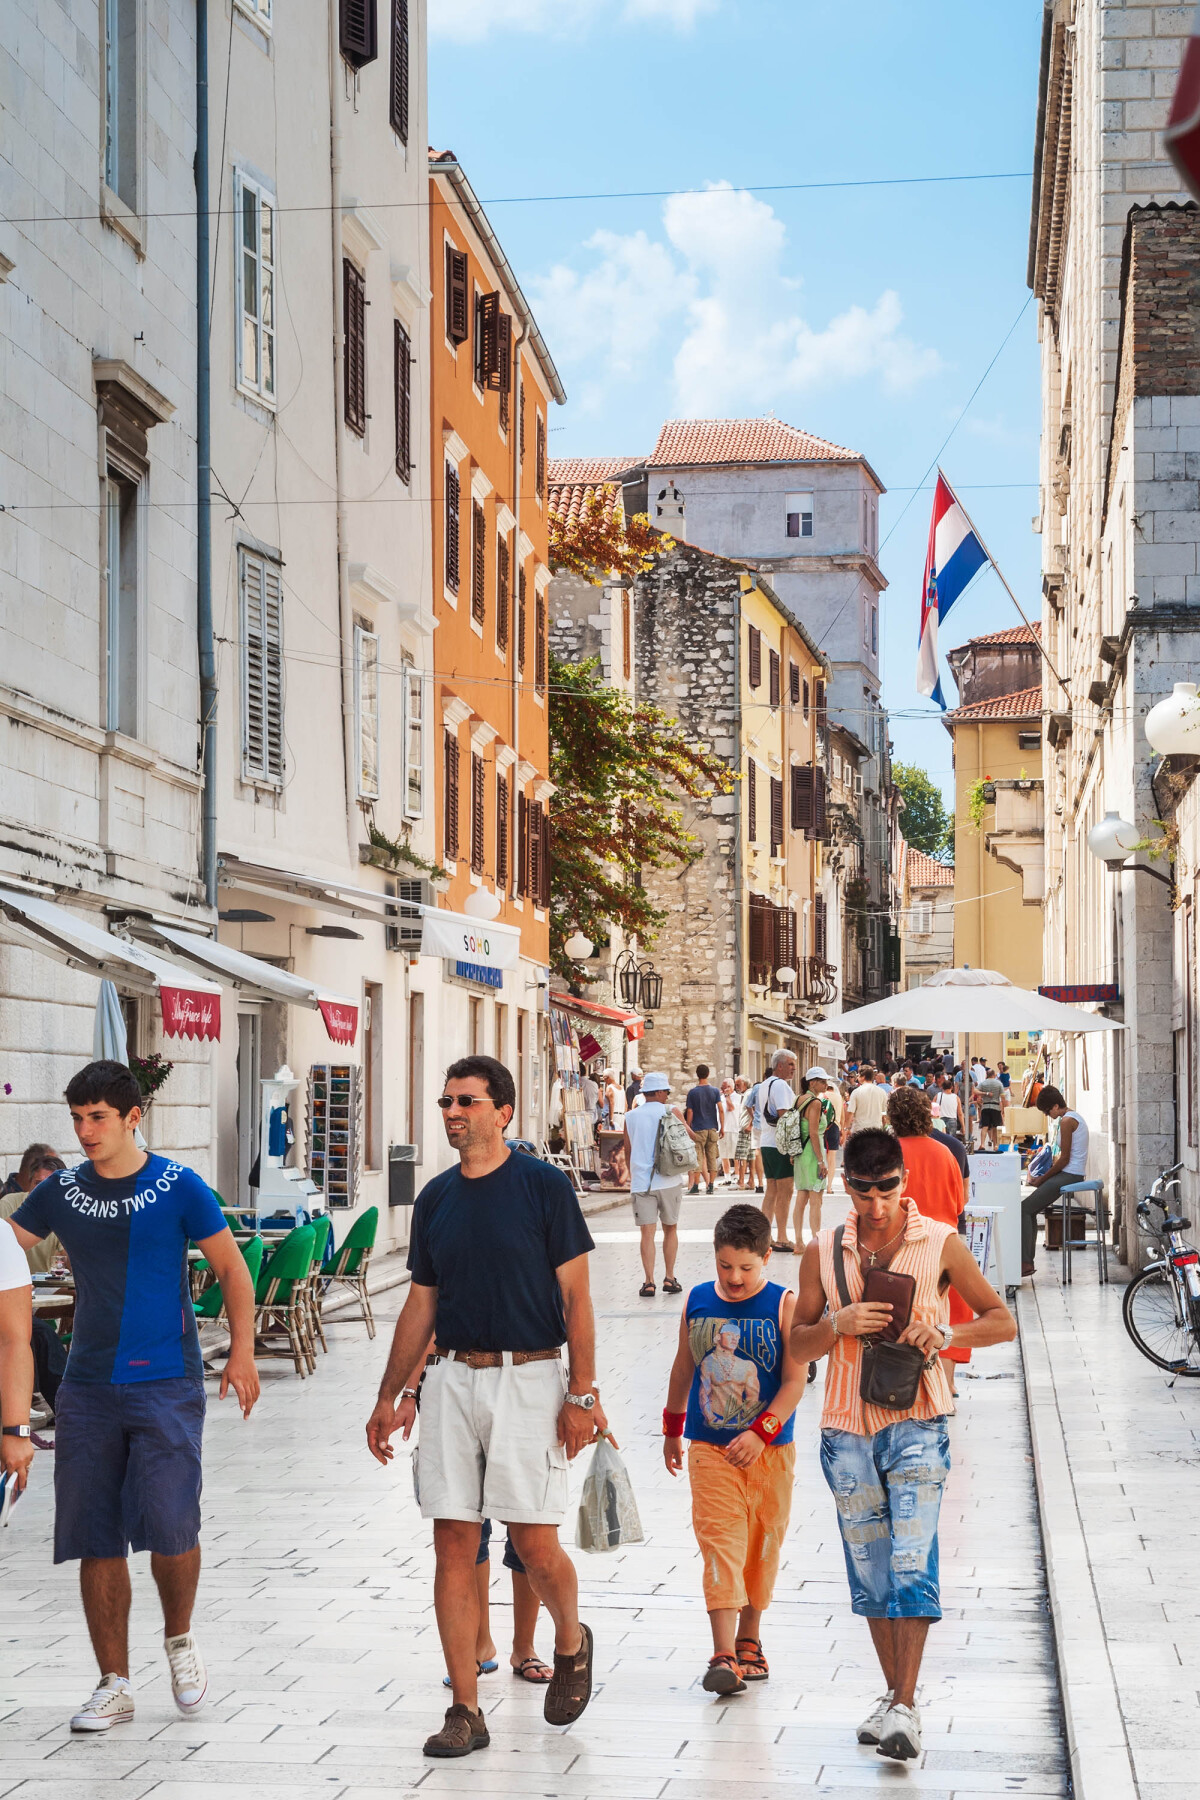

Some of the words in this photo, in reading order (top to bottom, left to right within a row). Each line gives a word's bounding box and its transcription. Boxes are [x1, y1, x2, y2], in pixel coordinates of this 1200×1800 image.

[463, 934, 490, 955] SOHO
[64, 1186, 118, 1218] OCEANS
[121, 1188, 157, 1216] TWO
